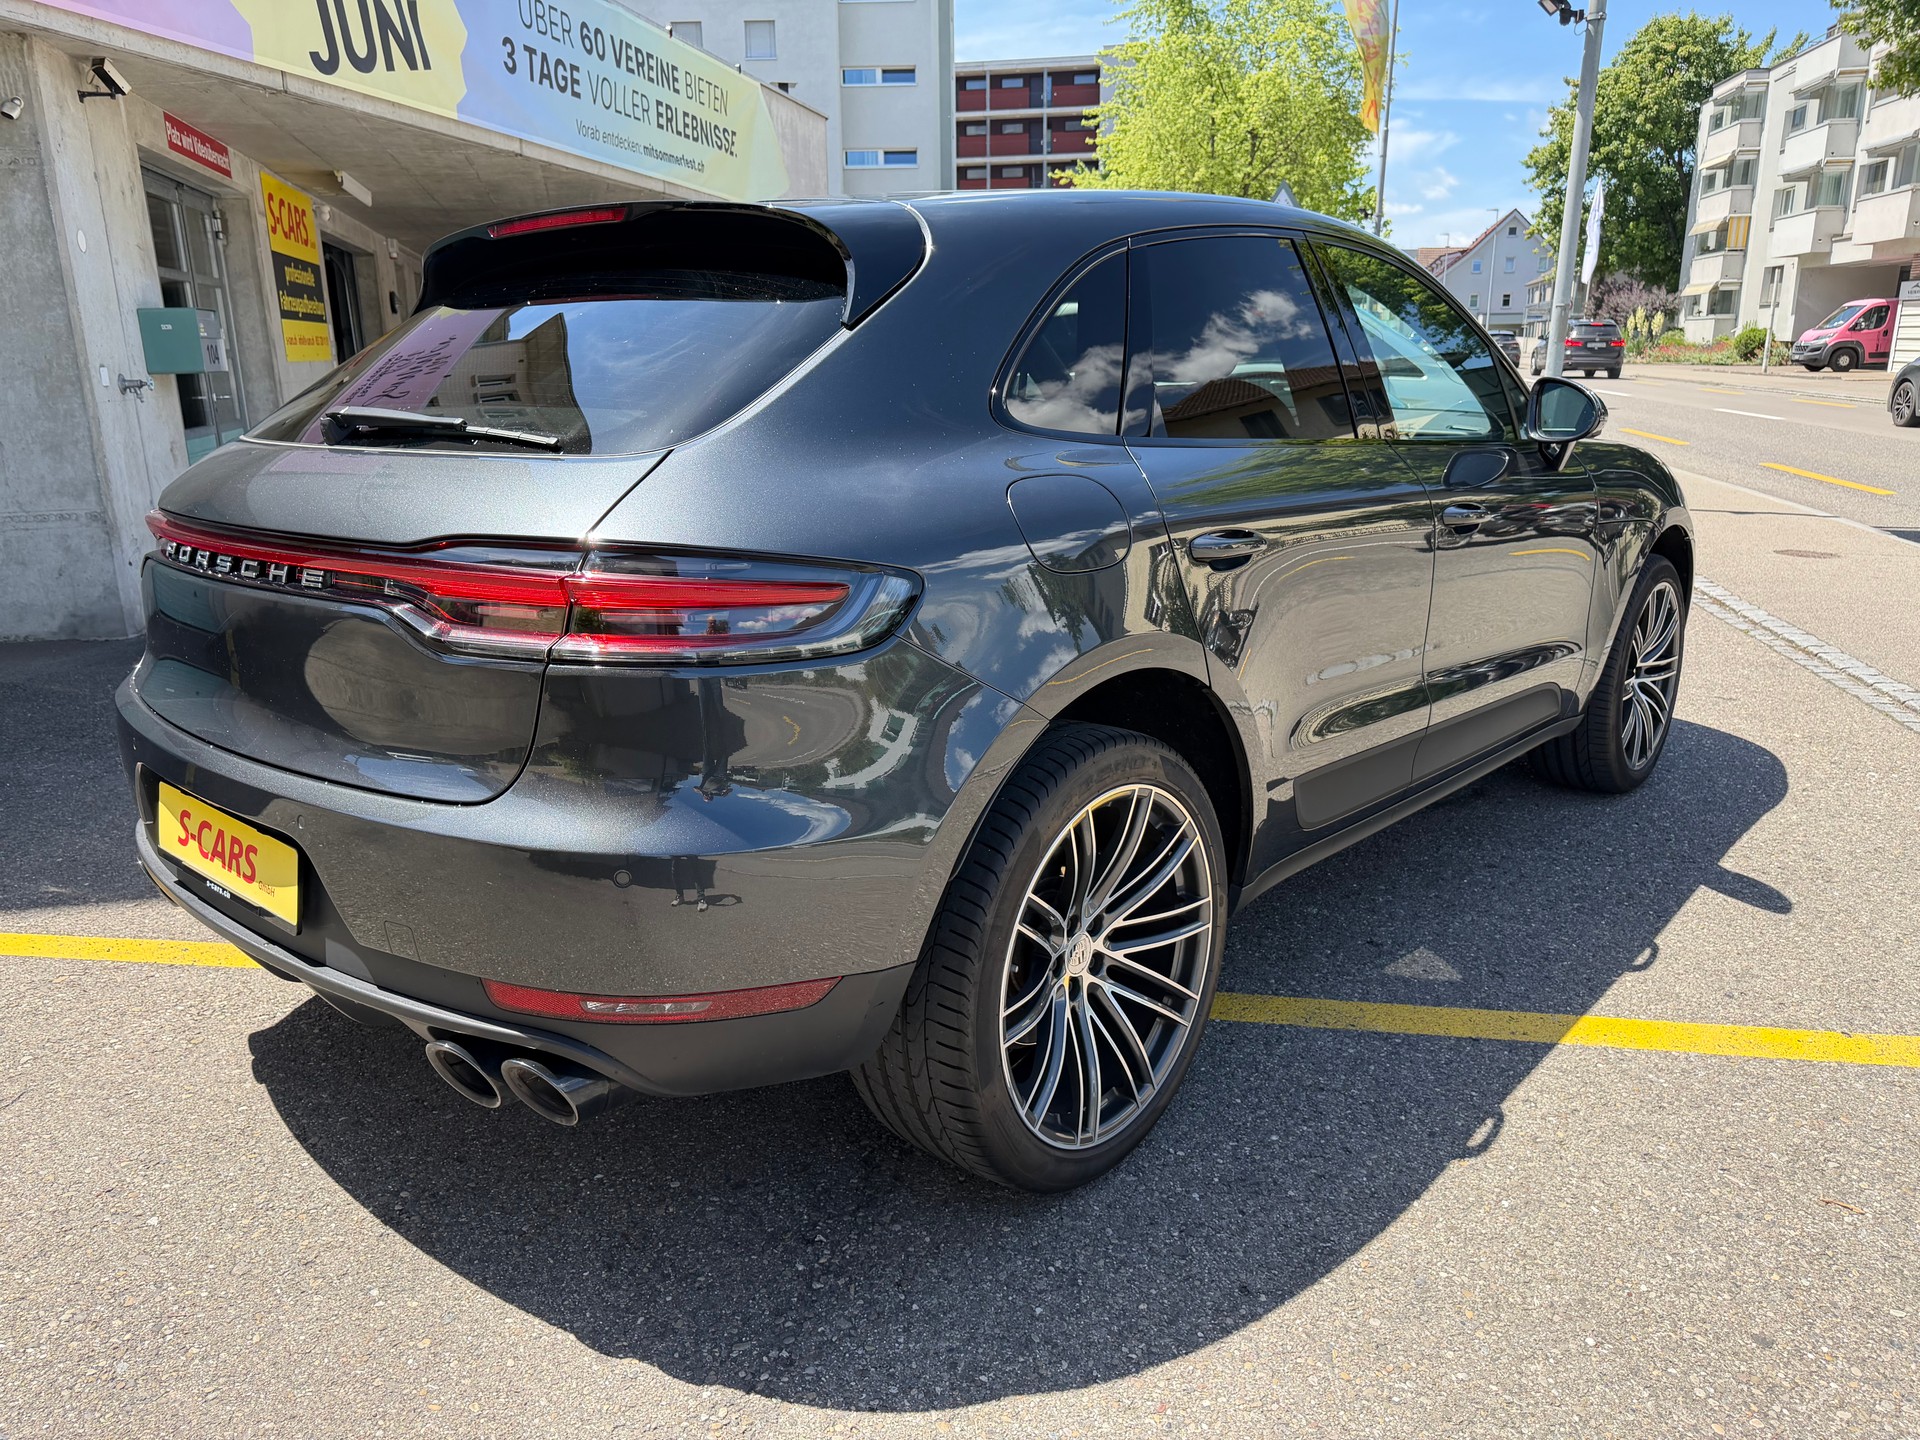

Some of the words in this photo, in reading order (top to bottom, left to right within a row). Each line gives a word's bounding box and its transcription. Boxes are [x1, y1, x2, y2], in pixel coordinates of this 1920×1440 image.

[309, 0, 432, 76] JUNI
[502, 36, 517, 75] 3
[522, 43, 581, 100] TAGE
[587, 70, 651, 125] VOLLER
[655, 99, 738, 158] ERLEBNISSE.
[580, 21, 606, 62] 60
[610, 34, 681, 95] VEREINE
[685, 71, 729, 117] BIETEN
[576, 118, 601, 142] Vorab
[602, 131, 643, 155] entdecken:
[643, 144, 705, 174] mitsommerfest.ch
[267, 191, 310, 248] S-CARS
[206, 344, 220, 365] 104
[166, 541, 325, 590] PORSCHE
[177, 809, 258, 885] S-CARS
[258, 880, 276, 898] GmbH
[206, 880, 231, 899] s-cars.ch
